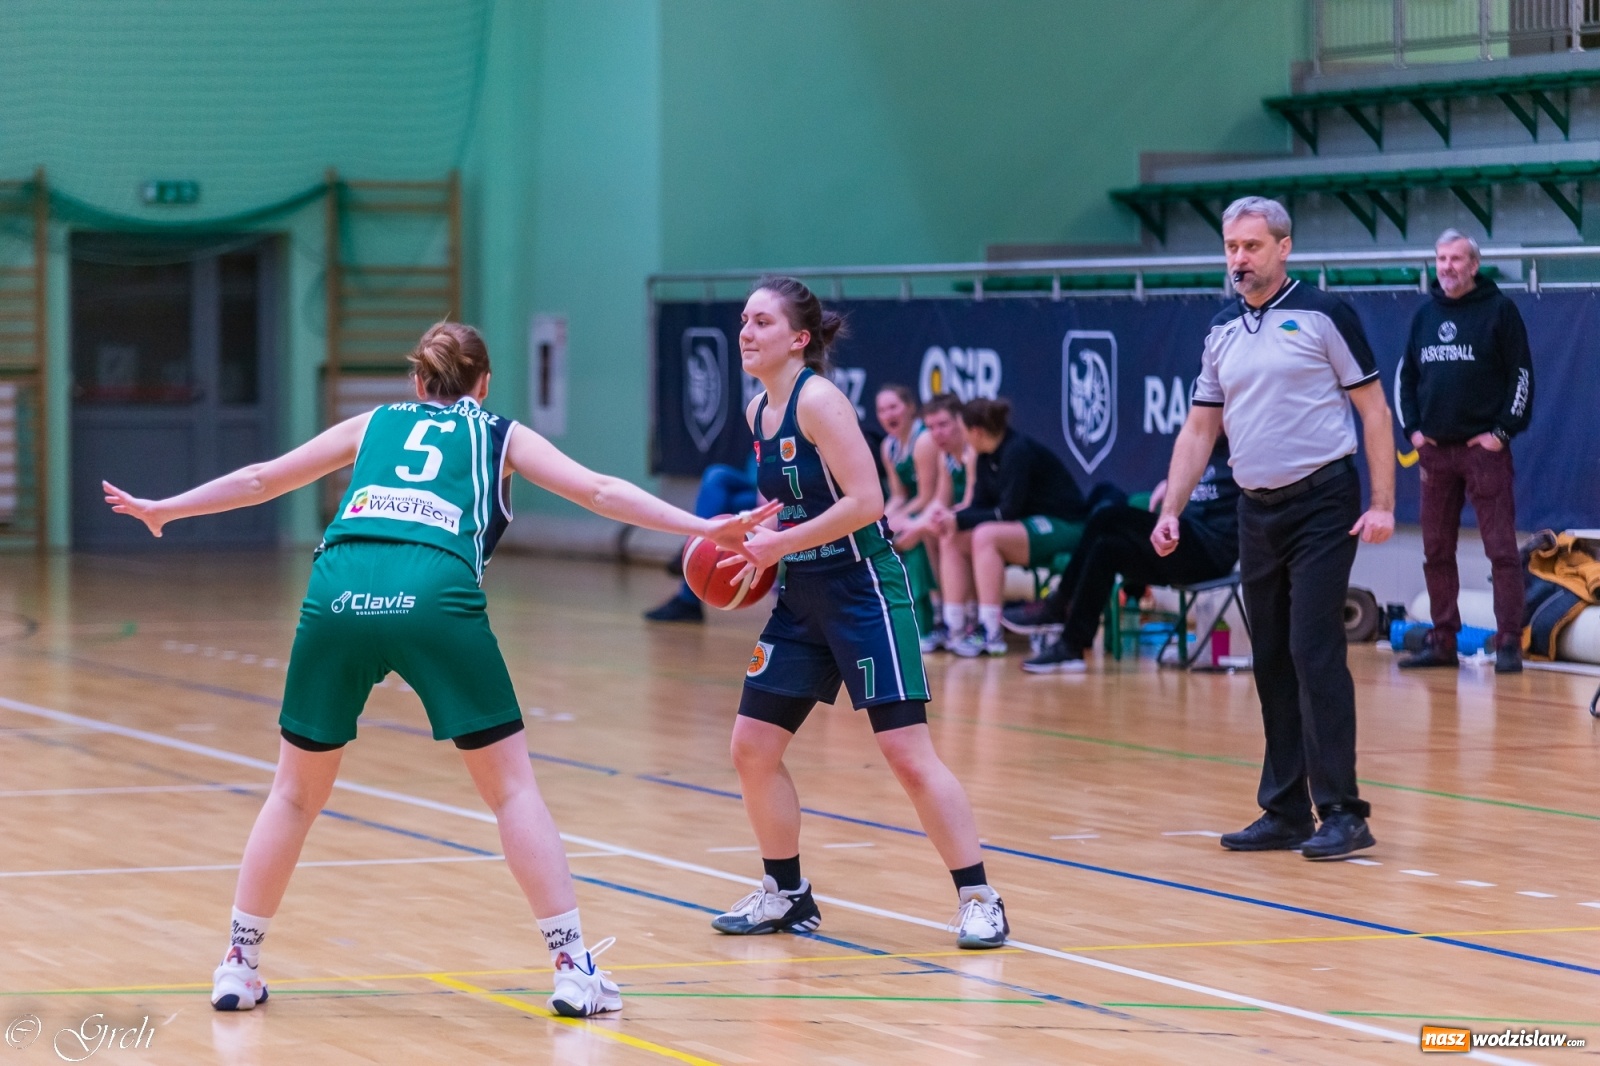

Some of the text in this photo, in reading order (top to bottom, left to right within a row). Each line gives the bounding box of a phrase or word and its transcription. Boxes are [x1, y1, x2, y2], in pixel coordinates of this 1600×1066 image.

[395, 419, 457, 482] 5
[369, 499, 455, 528] WAGTECH
[351, 591, 416, 610] Clavis
